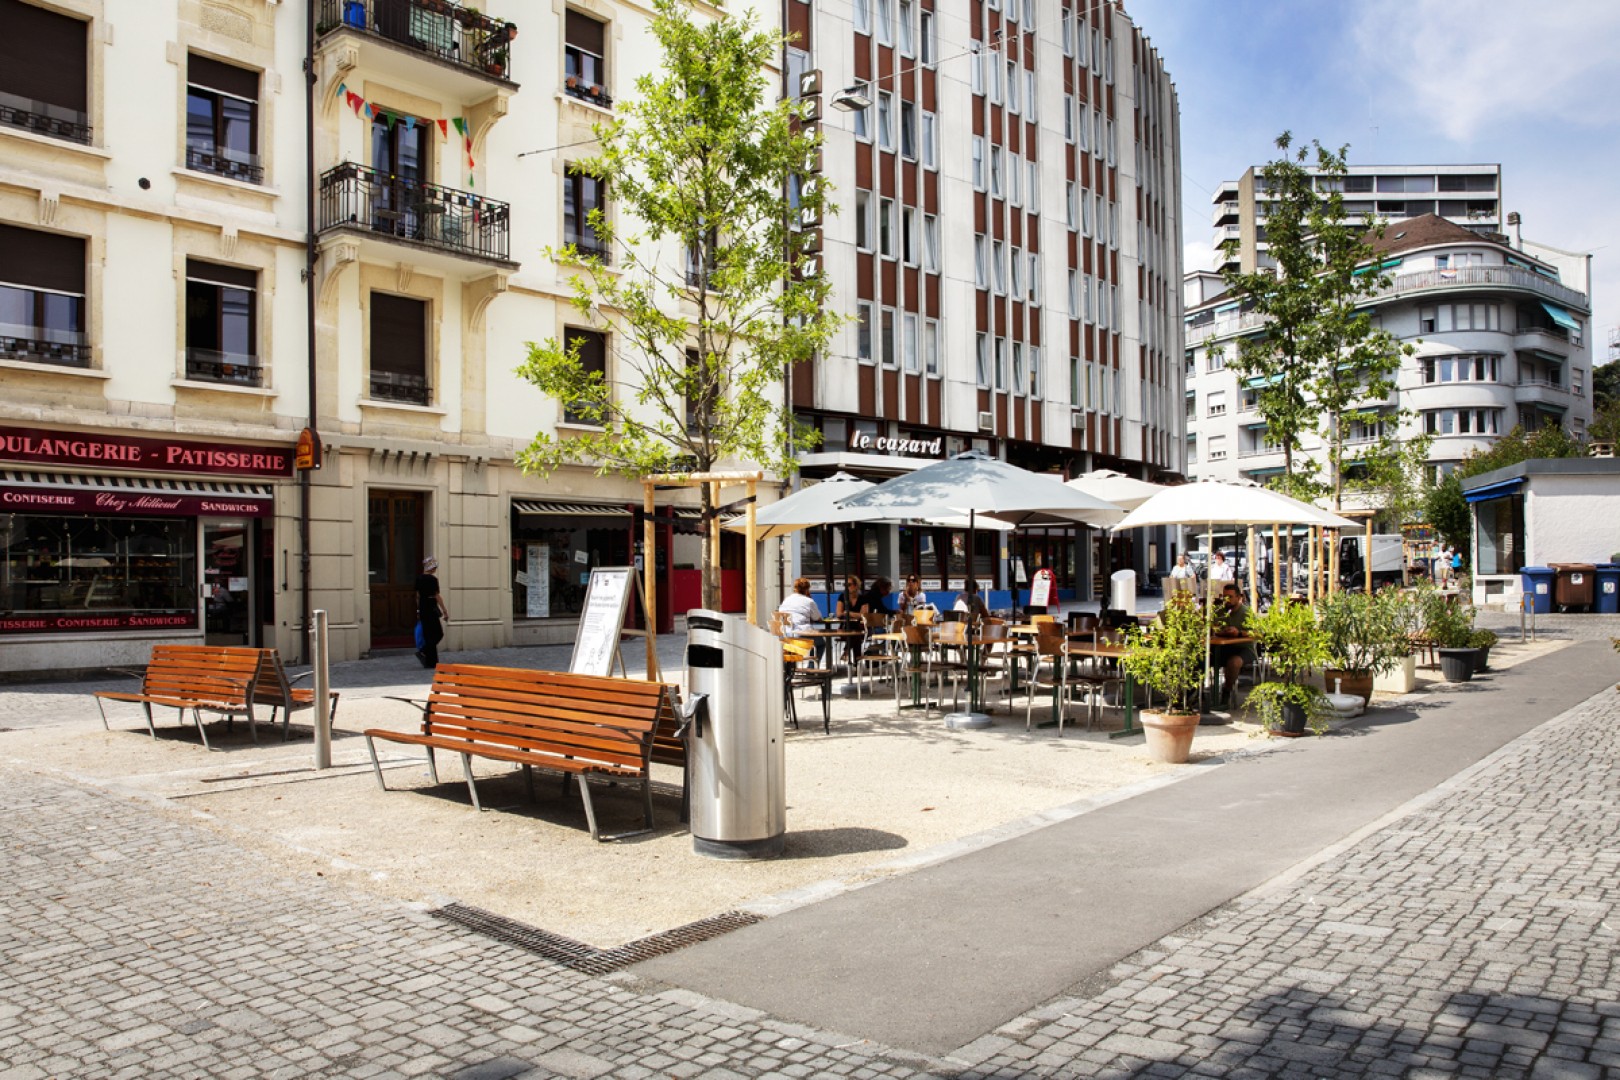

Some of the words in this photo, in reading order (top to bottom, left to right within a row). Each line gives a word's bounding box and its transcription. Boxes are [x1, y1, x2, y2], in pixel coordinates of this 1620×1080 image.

[801, 74, 818, 325] restaura
[852, 430, 870, 449] le
[876, 436, 942, 455] cazard
[166, 446, 285, 470] PATISSERIE
[3, 492, 75, 505] CONFISERIE
[95, 492, 127, 511] Chez
[57, 617, 120, 627] CONFISERIE
